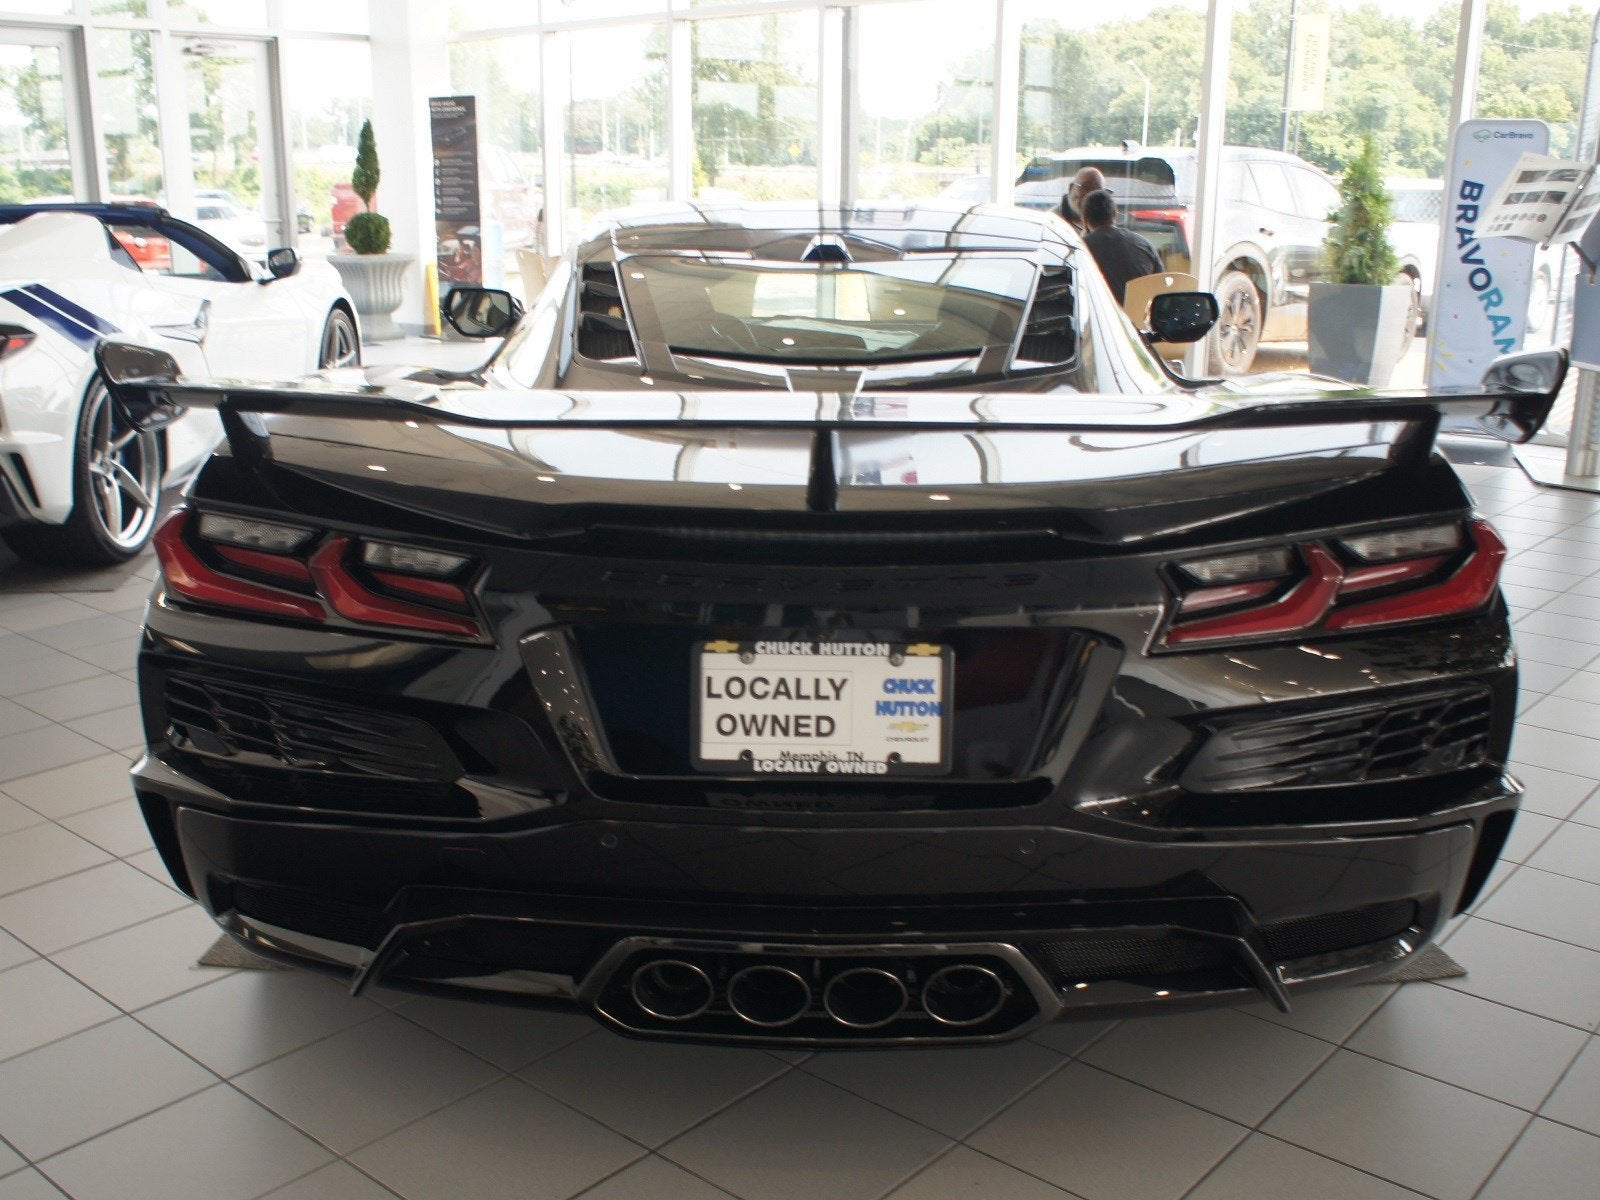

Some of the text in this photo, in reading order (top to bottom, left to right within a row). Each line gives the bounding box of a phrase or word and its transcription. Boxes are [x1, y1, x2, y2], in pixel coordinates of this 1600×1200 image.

[1493, 131, 1534, 139] CarBravo
[754, 641, 890, 657] CHUCK HUTTON
[706, 676, 848, 700] LOCALLY
[883, 678, 936, 694] CHUCK
[875, 700, 944, 717] HUTTON
[716, 713, 835, 738] OWNED
[753, 759, 888, 775] LOCALLY OWNED
